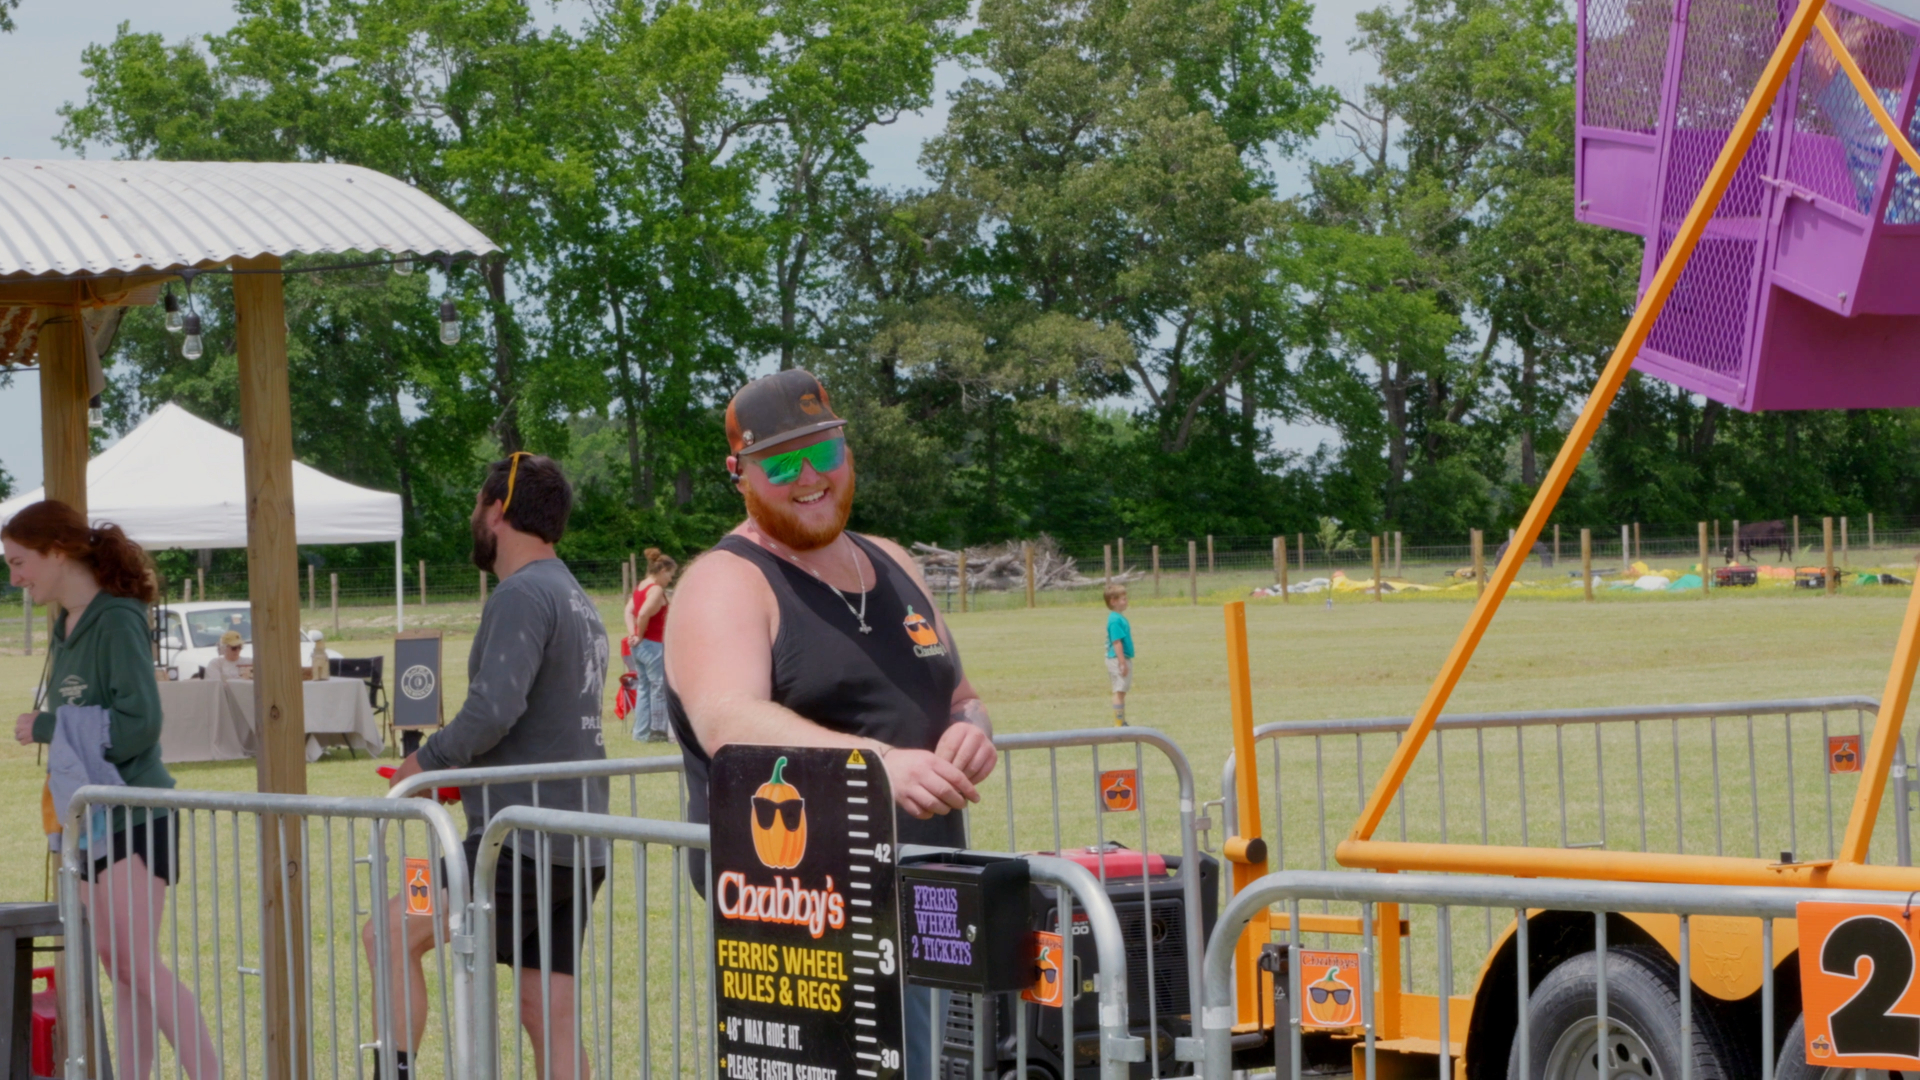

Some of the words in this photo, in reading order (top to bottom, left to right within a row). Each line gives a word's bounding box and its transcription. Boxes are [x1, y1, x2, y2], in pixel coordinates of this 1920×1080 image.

[874, 843, 891, 862] 42
[717, 871, 845, 939] Chubby's
[913, 885, 958, 913] FERRIS
[914, 910, 961, 938] WHEEL
[718, 939, 779, 973] FERRIS
[782, 946, 848, 981] WHEEL
[878, 938, 895, 975] 3
[911, 935, 919, 958] 2
[922, 936, 972, 966] TICKETS
[723, 970, 775, 1004] RULES
[779, 976, 794, 1006] &
[797, 979, 842, 1013] REGS
[1819, 915, 1920, 1059] 2
[744, 1018, 764, 1046] MAX
[766, 1021, 786, 1049] RIDE
[788, 1024, 802, 1051] HT.
[727, 1053, 759, 1080] PLEASE
[761, 1058, 793, 1080] FASTEN
[881, 1048, 899, 1070] 30
